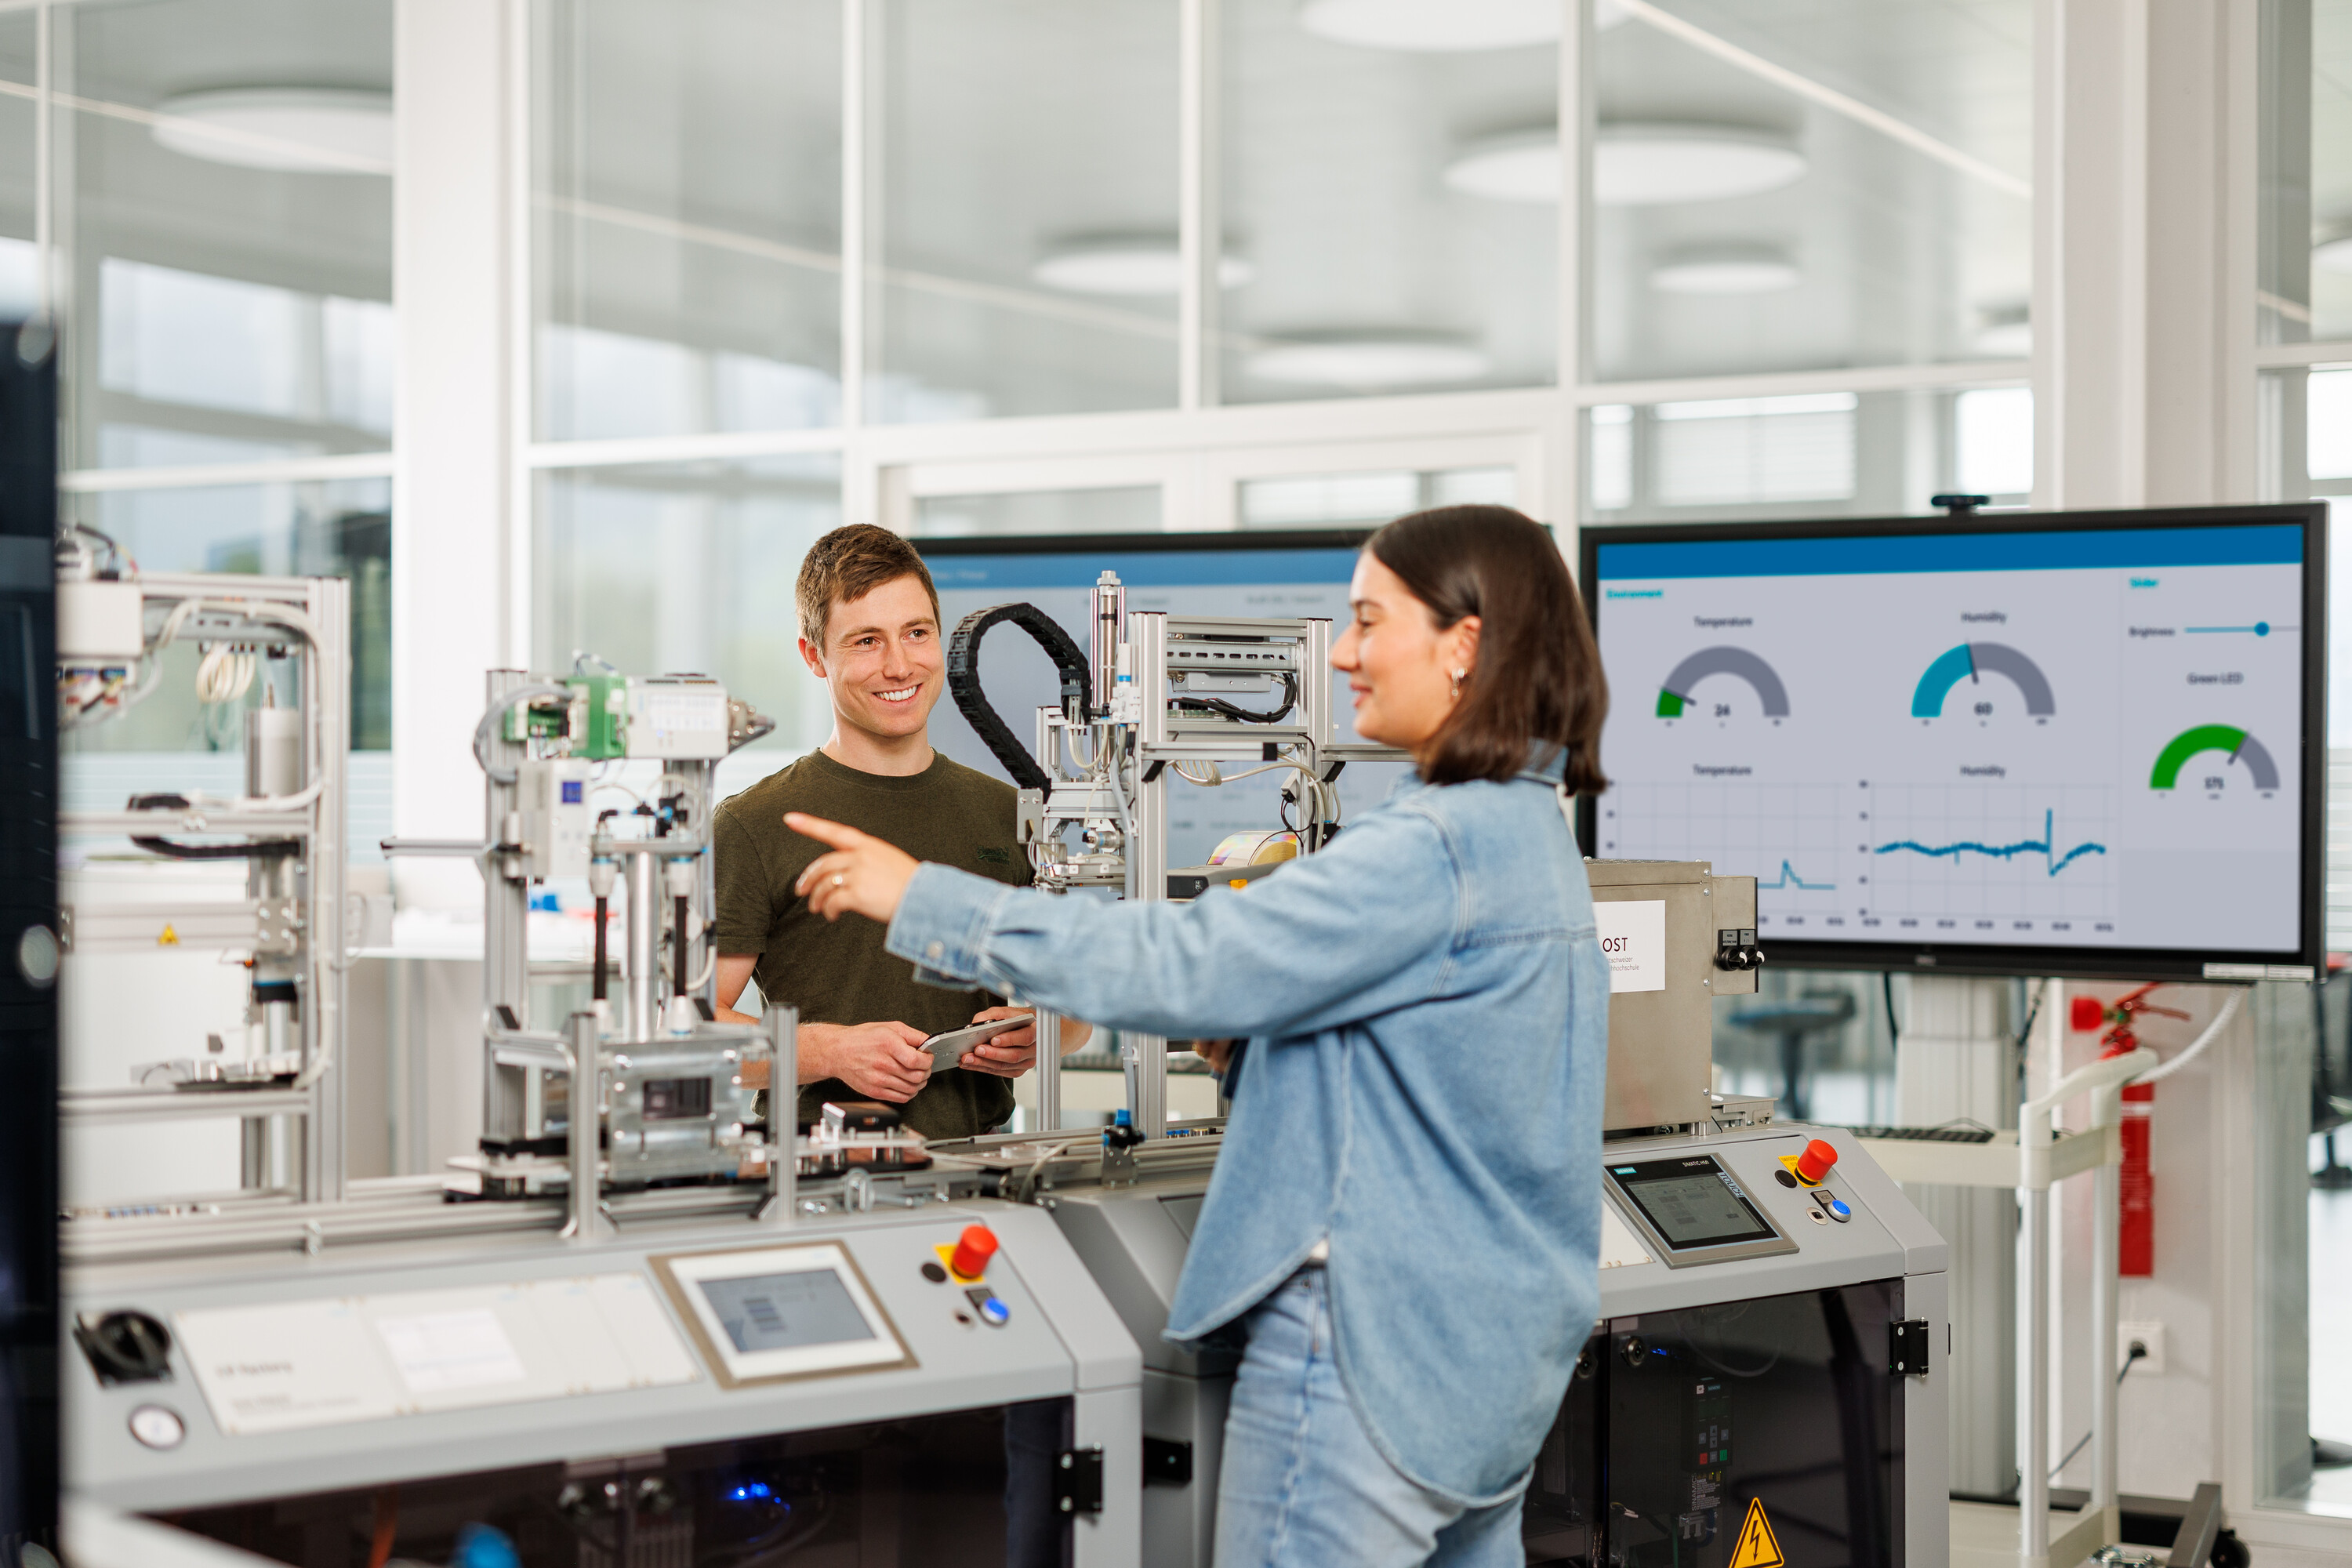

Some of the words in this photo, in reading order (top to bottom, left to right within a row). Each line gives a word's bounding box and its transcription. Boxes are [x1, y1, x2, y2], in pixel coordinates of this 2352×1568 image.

[1693, 617, 1753, 628] Temperature
[1962, 612, 2007, 625] Humidity
[2187, 673, 2219, 684] Green
[2220, 672, 2244, 684] LED
[1974, 702, 1993, 715] 60
[1693, 764, 1752, 776] Temperature
[1961, 765, 2006, 778] Humidity
[1602, 938, 1628, 952] OST
[1720, 1173, 1745, 1197] TOUCH
